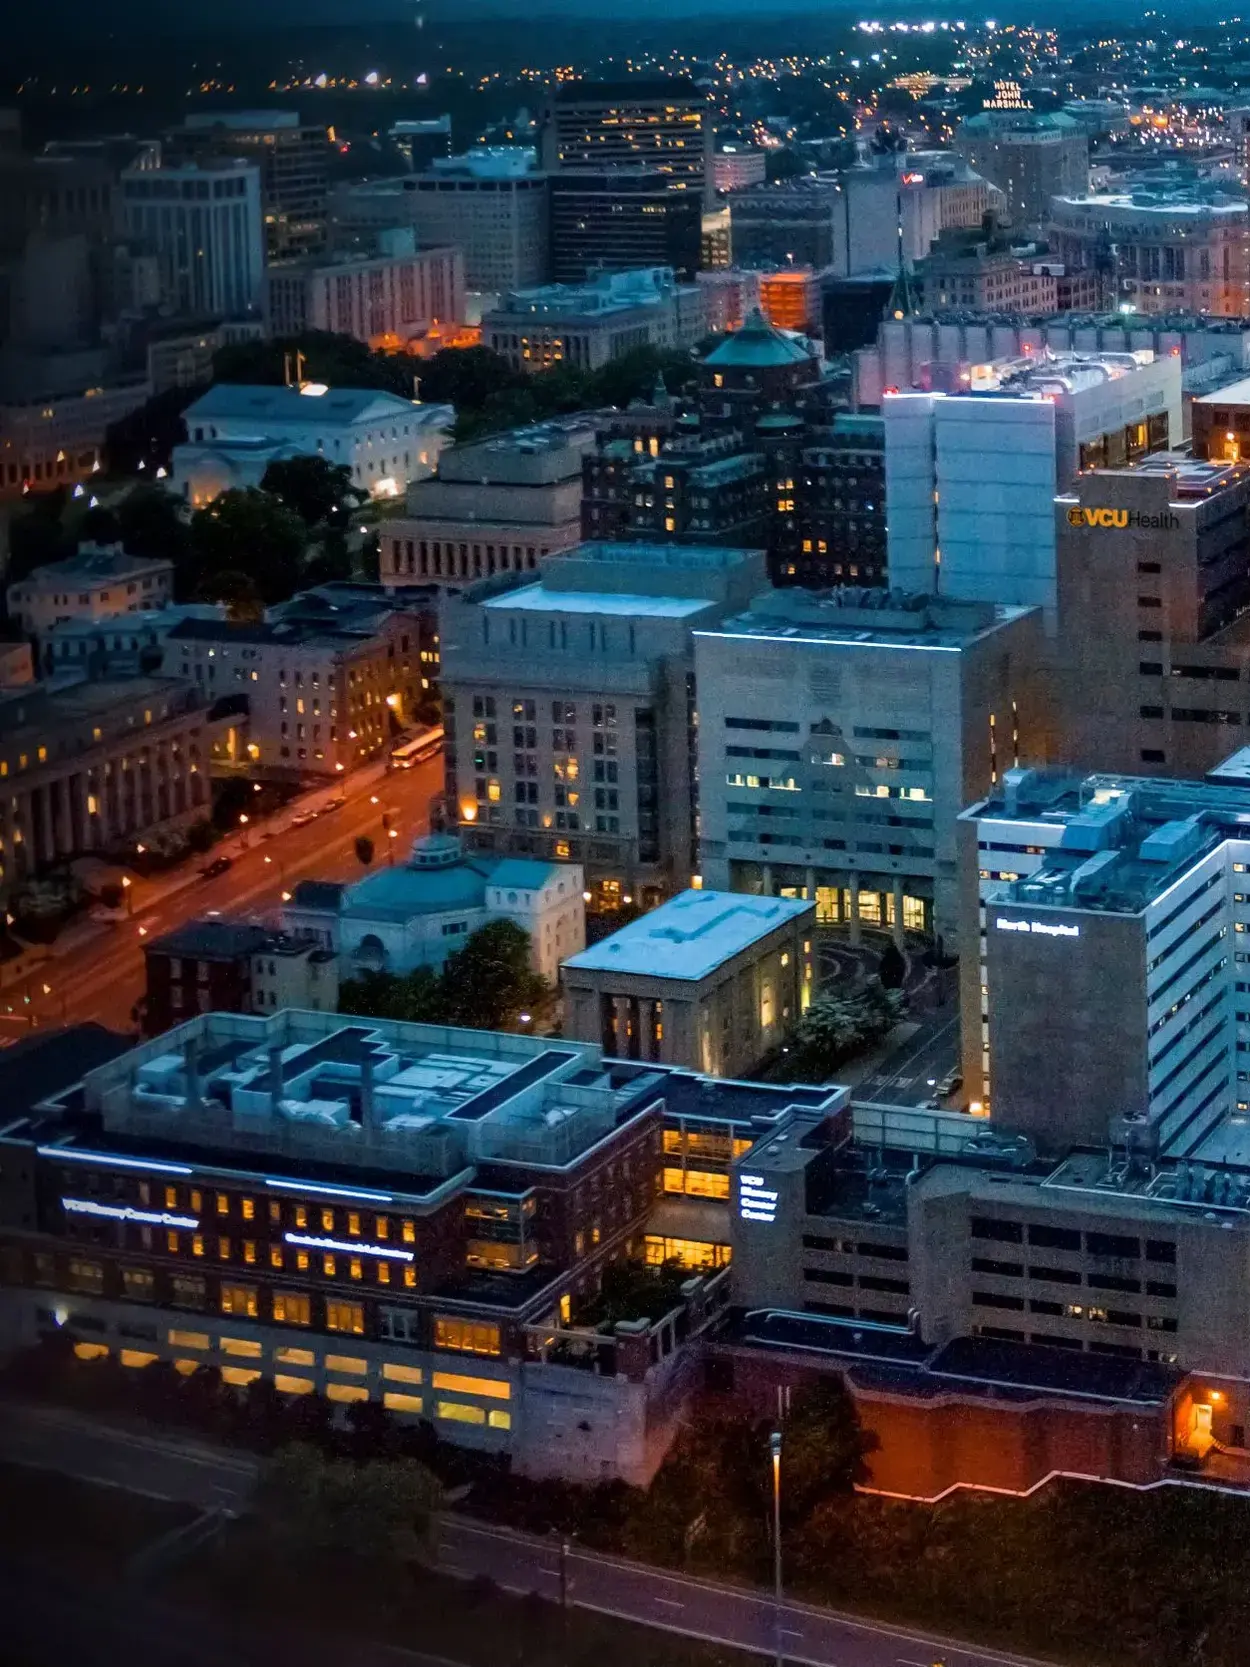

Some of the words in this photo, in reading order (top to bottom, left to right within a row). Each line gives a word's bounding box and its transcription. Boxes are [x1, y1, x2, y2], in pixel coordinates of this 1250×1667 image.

[994, 81, 1021, 91] HOTEL
[995, 90, 1021, 100] JOHN
[983, 99, 1034, 109] MARSHALL
[1085, 507, 1128, 528] VCU
[1128, 511, 1180, 529] Health
